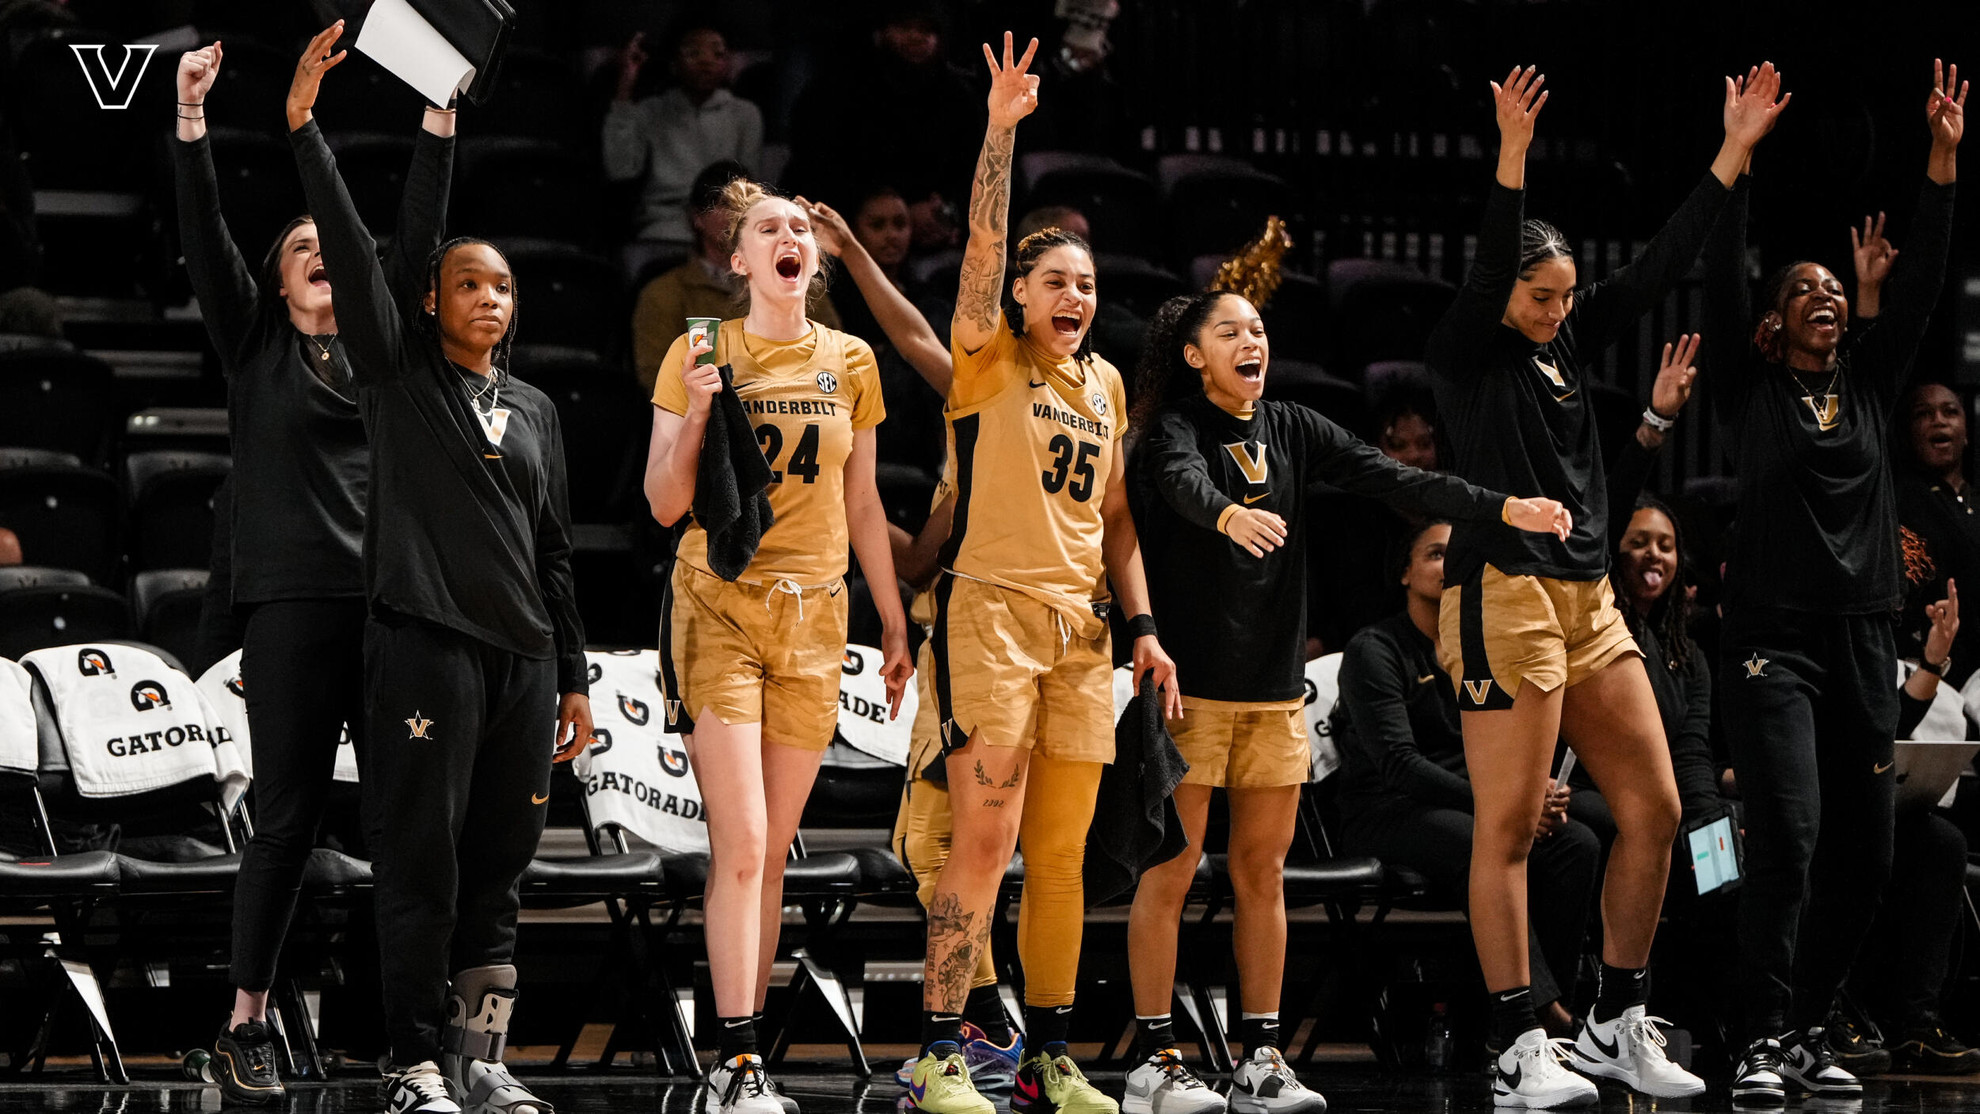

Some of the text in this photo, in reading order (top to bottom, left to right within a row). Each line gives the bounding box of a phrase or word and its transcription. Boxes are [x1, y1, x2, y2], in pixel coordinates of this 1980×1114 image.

[817, 372, 836, 393] SEC
[742, 400, 836, 417] ANDERBILT
[1033, 402, 1109, 440] VANDERBIT
[755, 423, 820, 484] 24
[1042, 434, 1100, 503] 35
[1222, 440, 1268, 484] V
[1463, 679, 1493, 705] V
[666, 699, 681, 726] V
